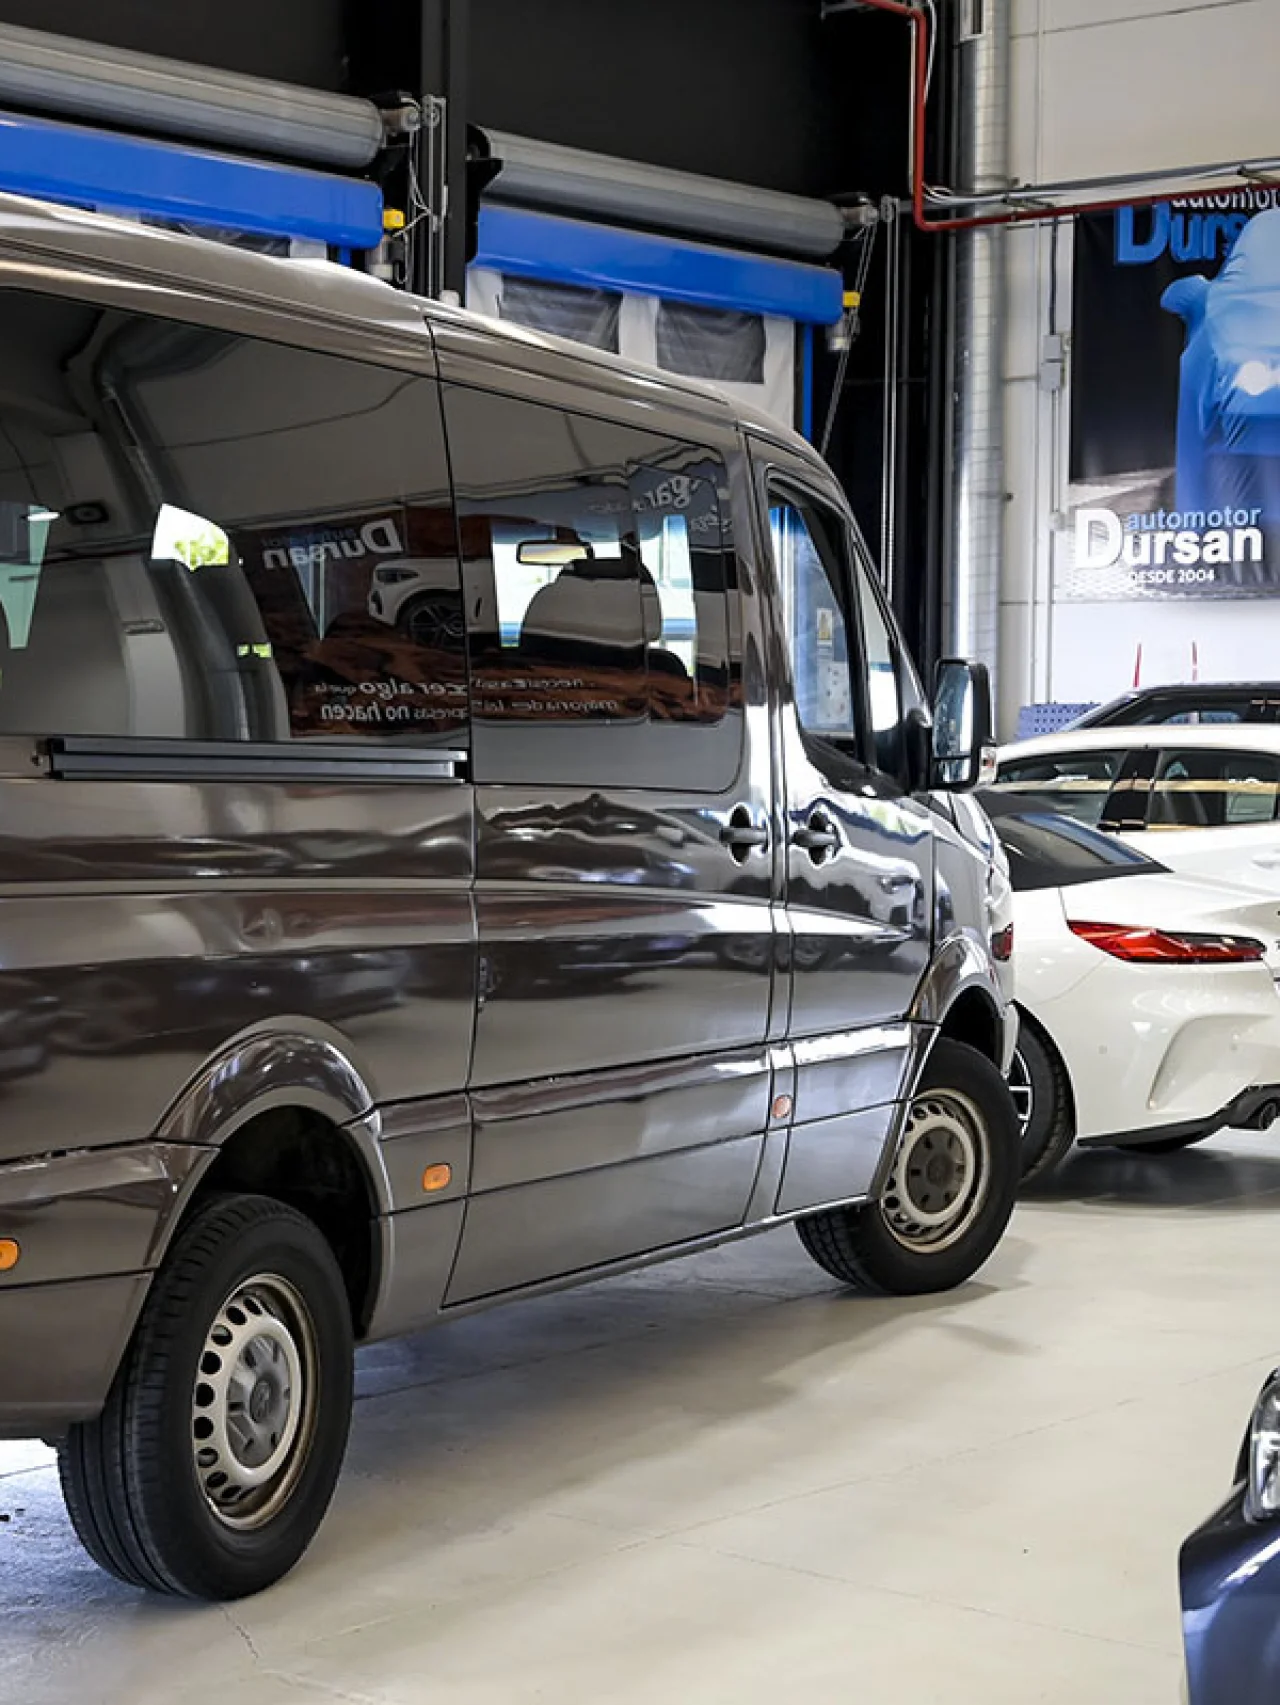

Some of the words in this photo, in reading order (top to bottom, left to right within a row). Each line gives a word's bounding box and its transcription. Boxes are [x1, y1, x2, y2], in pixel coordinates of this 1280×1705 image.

[1127, 506, 1263, 531] automotor
[1075, 508, 1263, 570] Dursan
[1177, 568, 1216, 582] 2004
